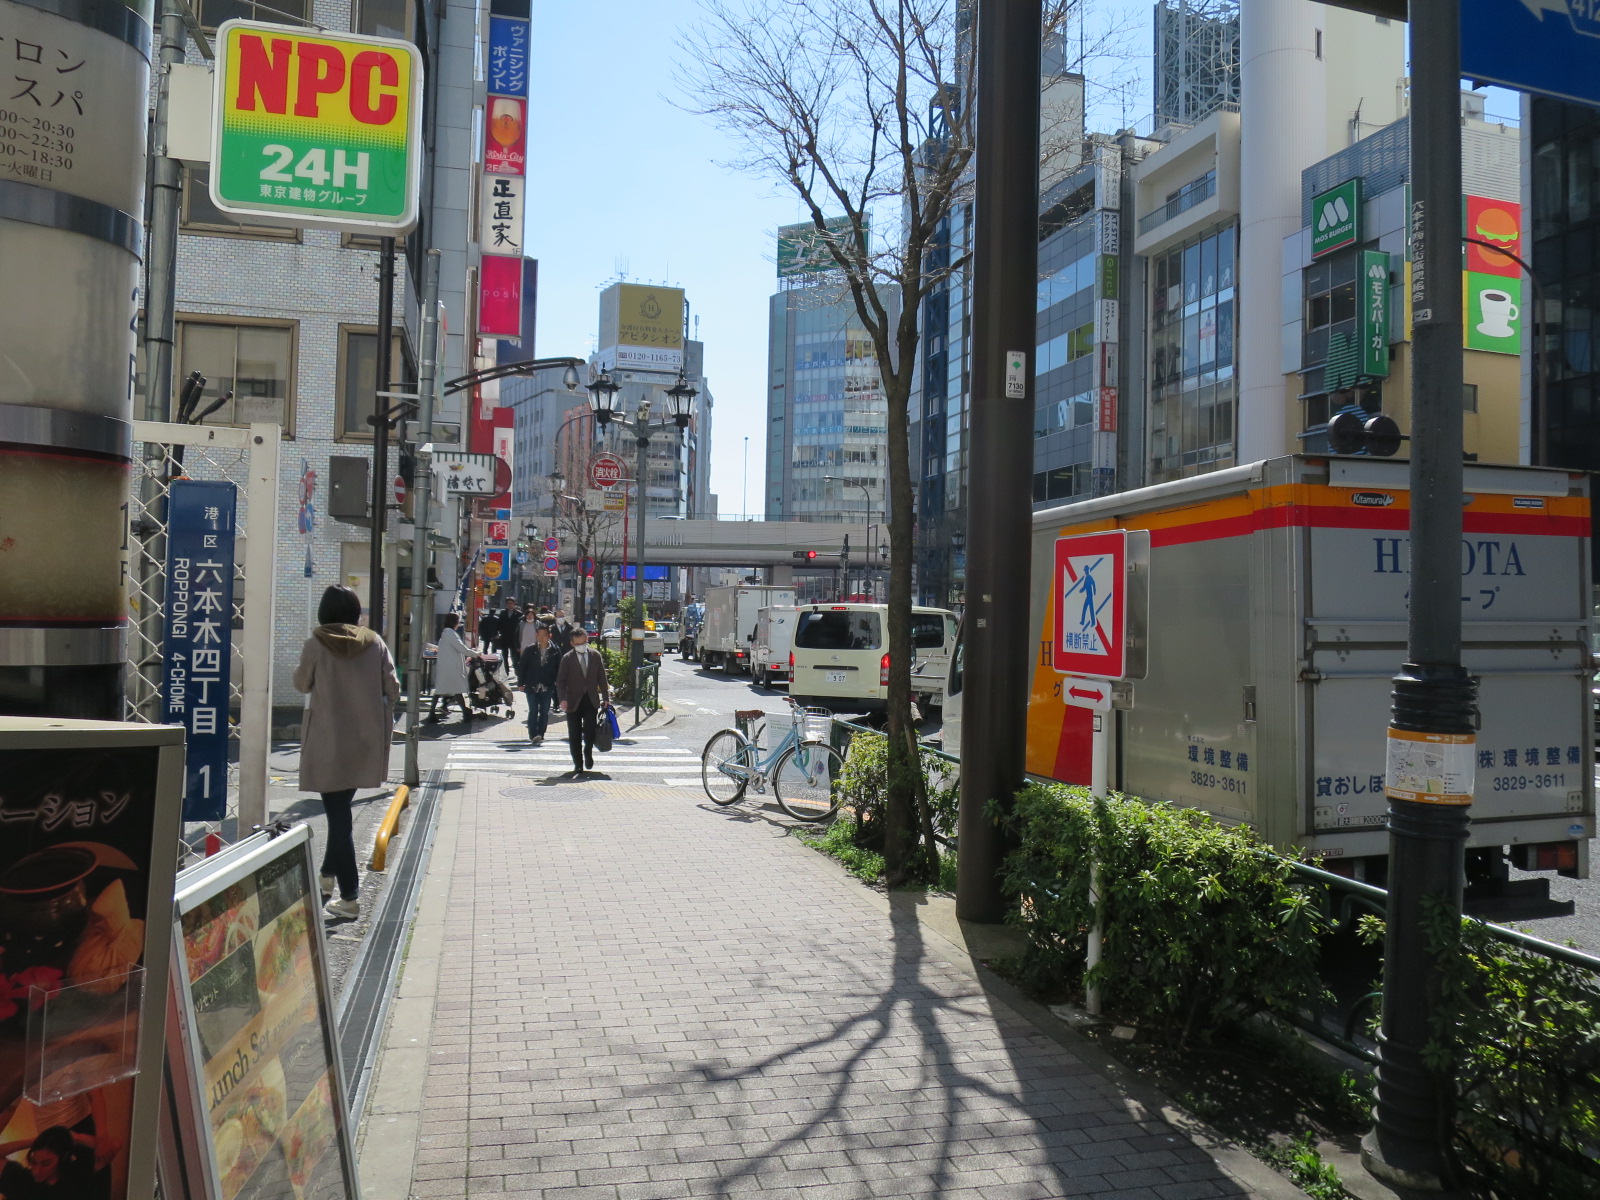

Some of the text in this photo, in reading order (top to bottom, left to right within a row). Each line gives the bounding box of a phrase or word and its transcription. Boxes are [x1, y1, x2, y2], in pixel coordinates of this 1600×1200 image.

[0, 36, 86, 74] ロン
[492, 45, 507, 90] ポイント
[509, 25, 525, 92] ヴァニシング
[10, 75, 84, 116] スパ
[236, 34, 399, 126] NPC
[259, 144, 370, 191] 24H
[259, 184, 368, 206] 東京建物グループ
[492, 179, 518, 247] 正直家
[1314, 222, 1353, 245] MOS BURGER
[482, 282, 518, 308] posh
[1371, 281, 1385, 362] モスバーガー
[1008, 382, 1024, 391] 7130
[595, 466, 619, 479] 消火栓
[204, 506, 220, 549] 港区
[171, 557, 190, 639] ROPPONGI
[191, 559, 224, 735] 六本木四丁目
[1066, 631, 1098, 652] 横断禁止
[169, 652, 187, 714] 4-CHOME
[1188, 745, 1248, 772] 環境整備
[1190, 770, 1247, 795] 3829-3611
[1493, 773, 1565, 791] 3829-3611
[1, 791, 130, 831] ーション
[1306, 847, 1344, 857] CATER
